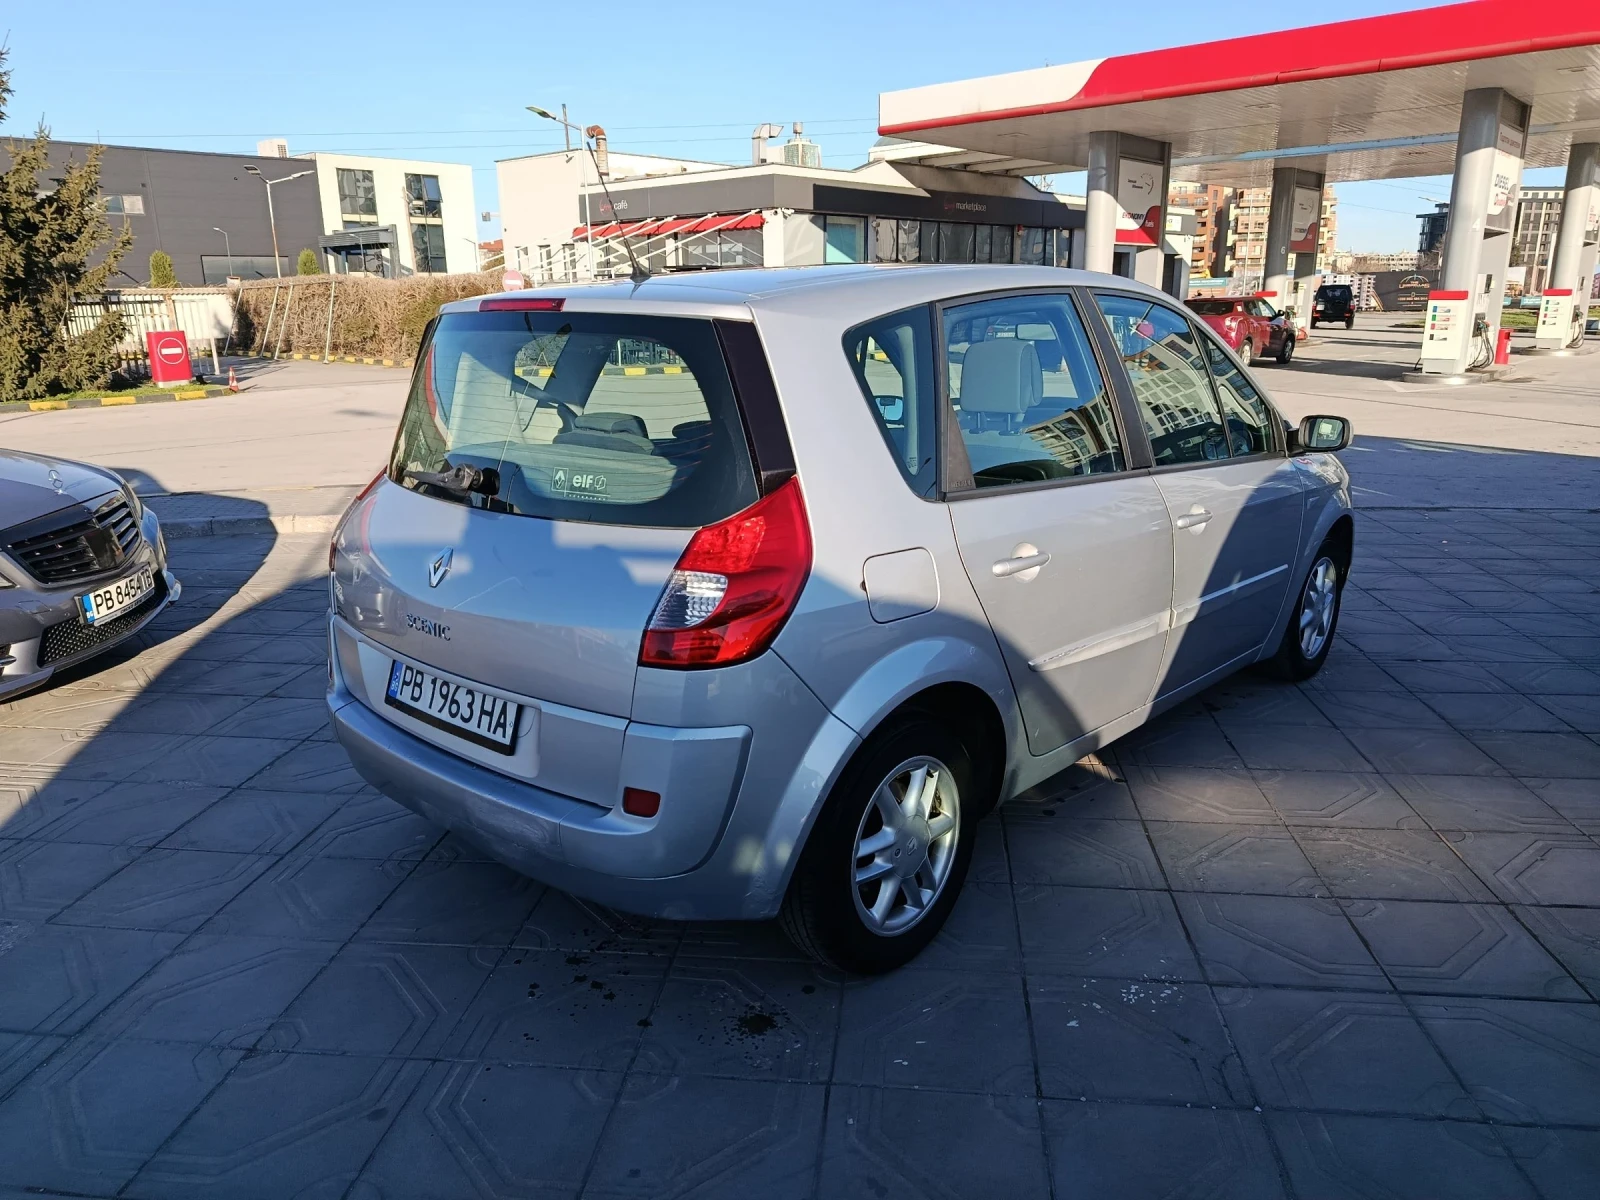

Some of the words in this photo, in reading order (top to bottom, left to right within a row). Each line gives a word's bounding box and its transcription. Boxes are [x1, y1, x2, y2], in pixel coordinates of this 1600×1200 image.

[614, 199, 628, 210] café
[956, 201, 986, 212] marketplace
[572, 474, 594, 489] elf
[94, 590, 114, 614] PB
[406, 613, 451, 641] SCENIC
[400, 665, 424, 703] PB
[428, 677, 475, 724] 1963
[476, 693, 508, 739] HA
